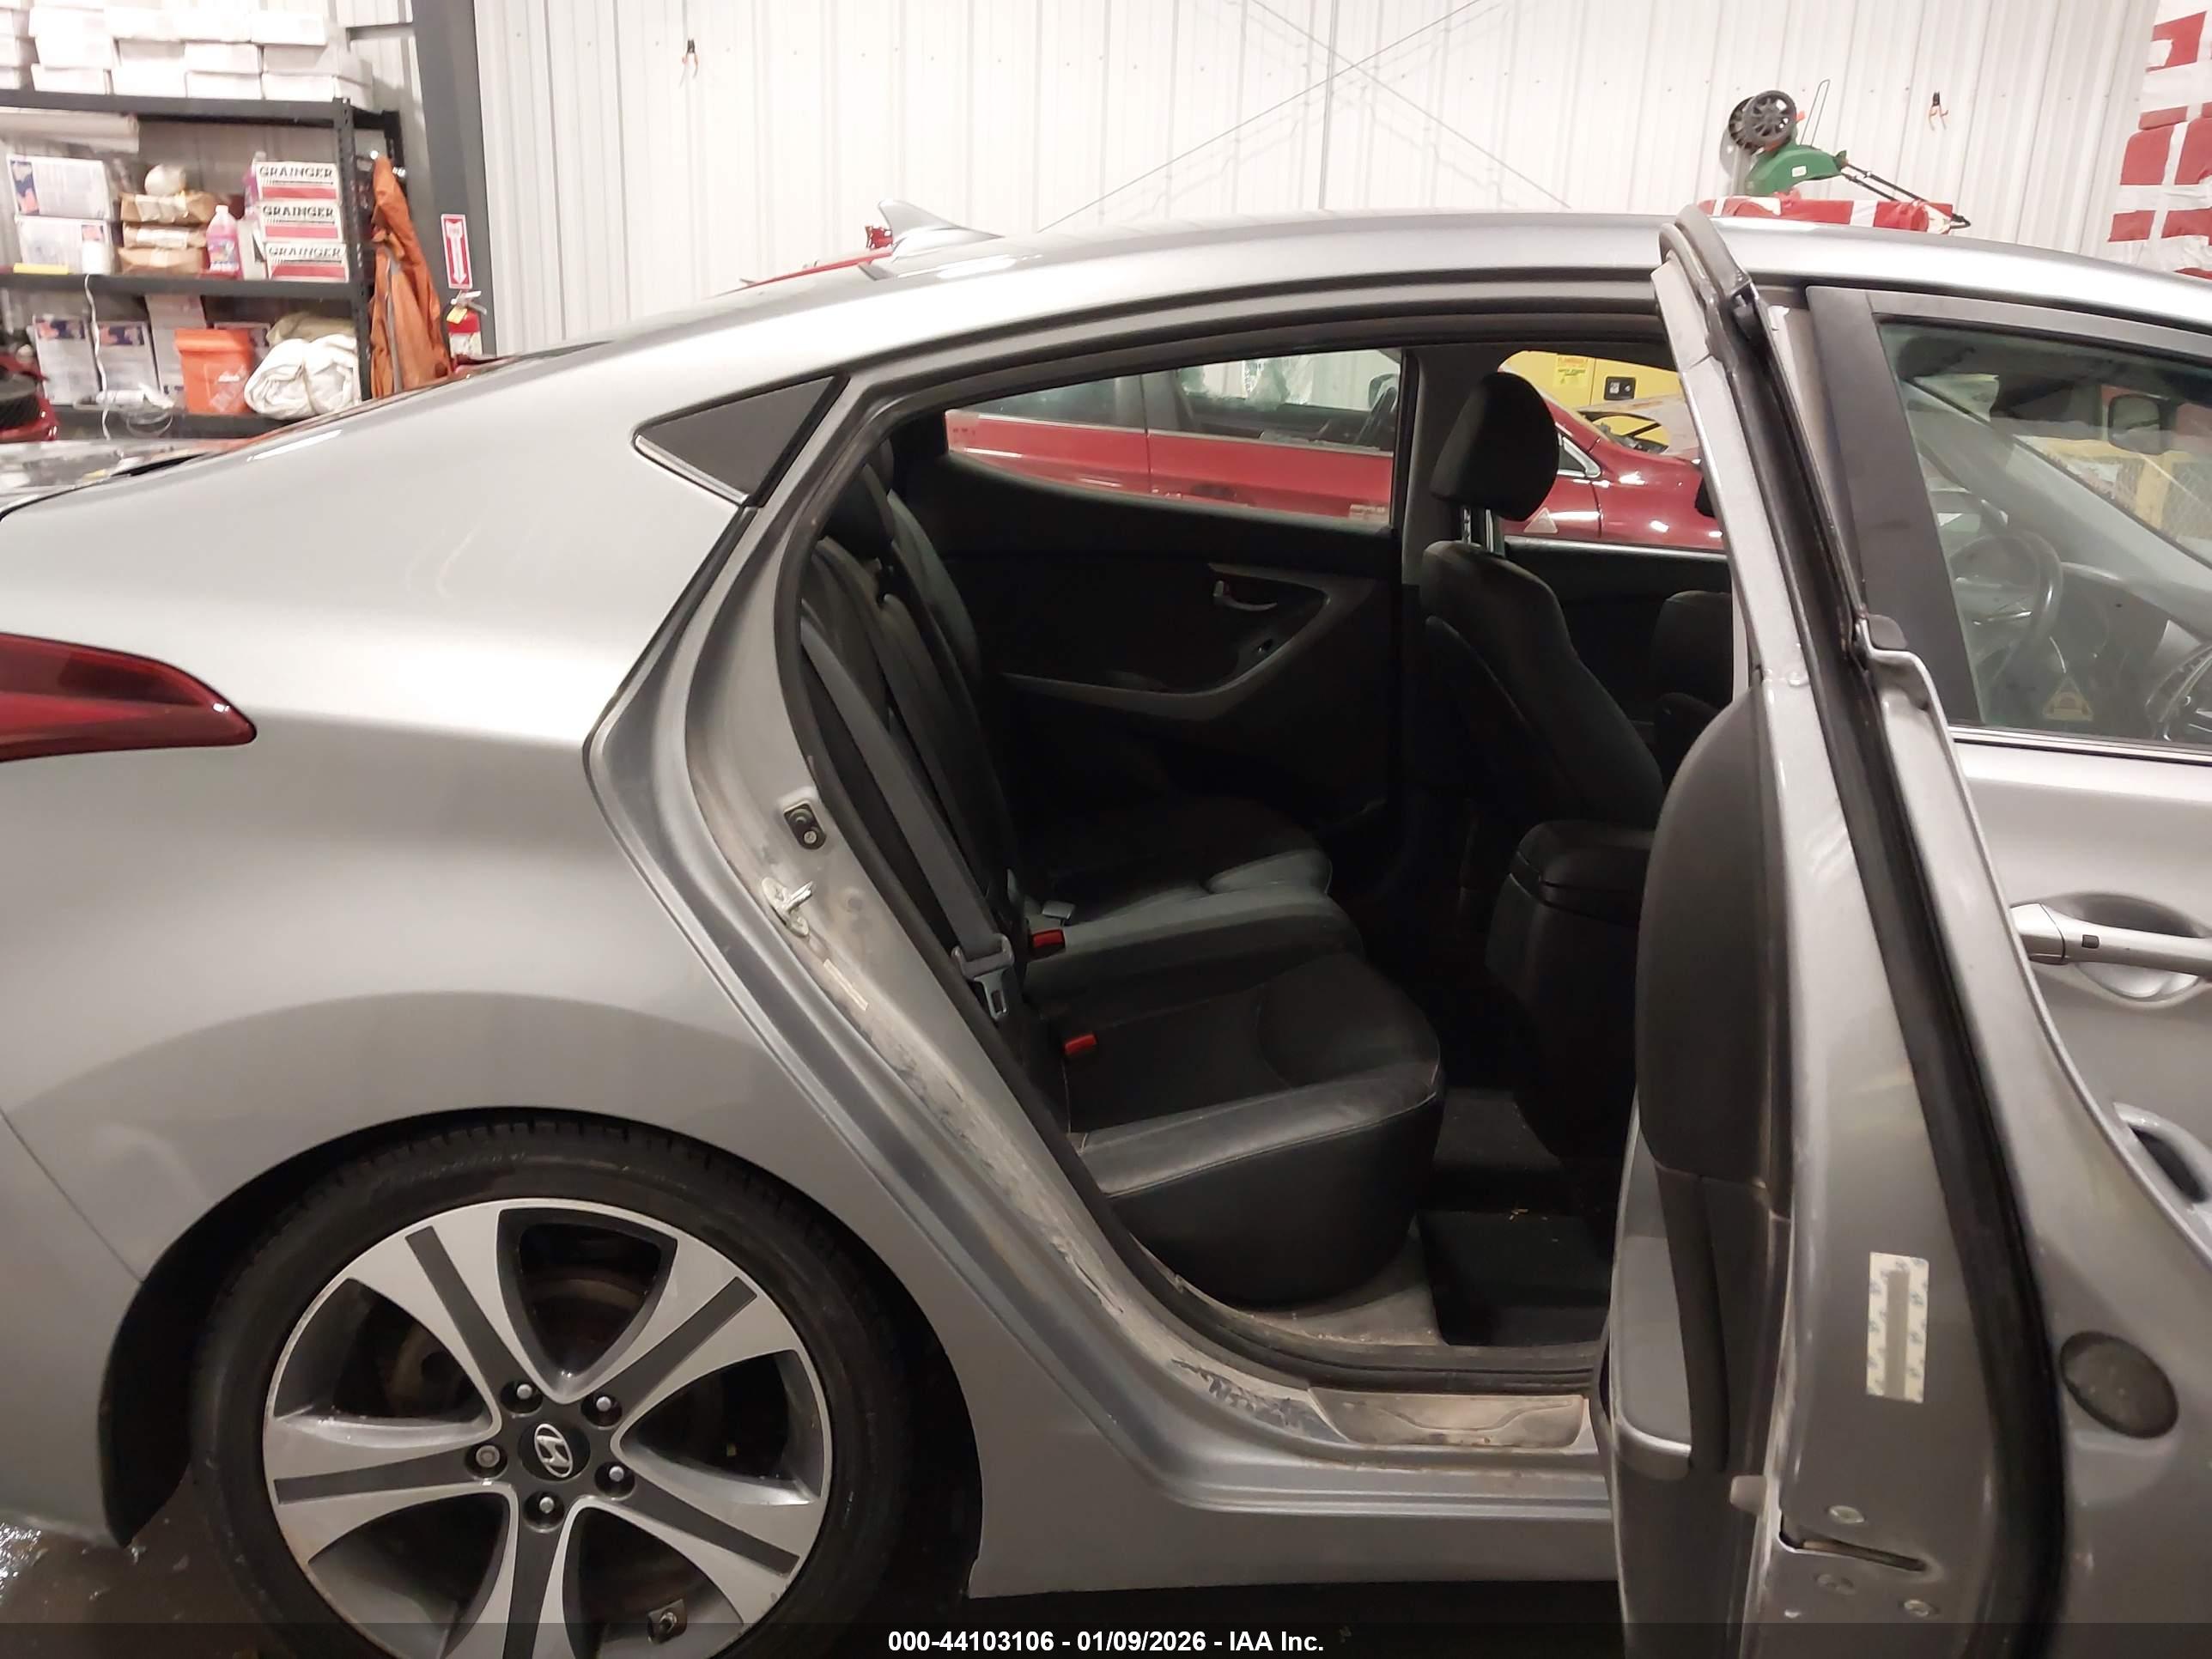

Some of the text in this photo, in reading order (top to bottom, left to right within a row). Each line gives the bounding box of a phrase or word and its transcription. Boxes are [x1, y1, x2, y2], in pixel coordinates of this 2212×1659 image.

[259, 165, 332, 179] GRAINGER
[263, 205, 334, 216] GRAINGER
[268, 246, 341, 258] GRAINGER
